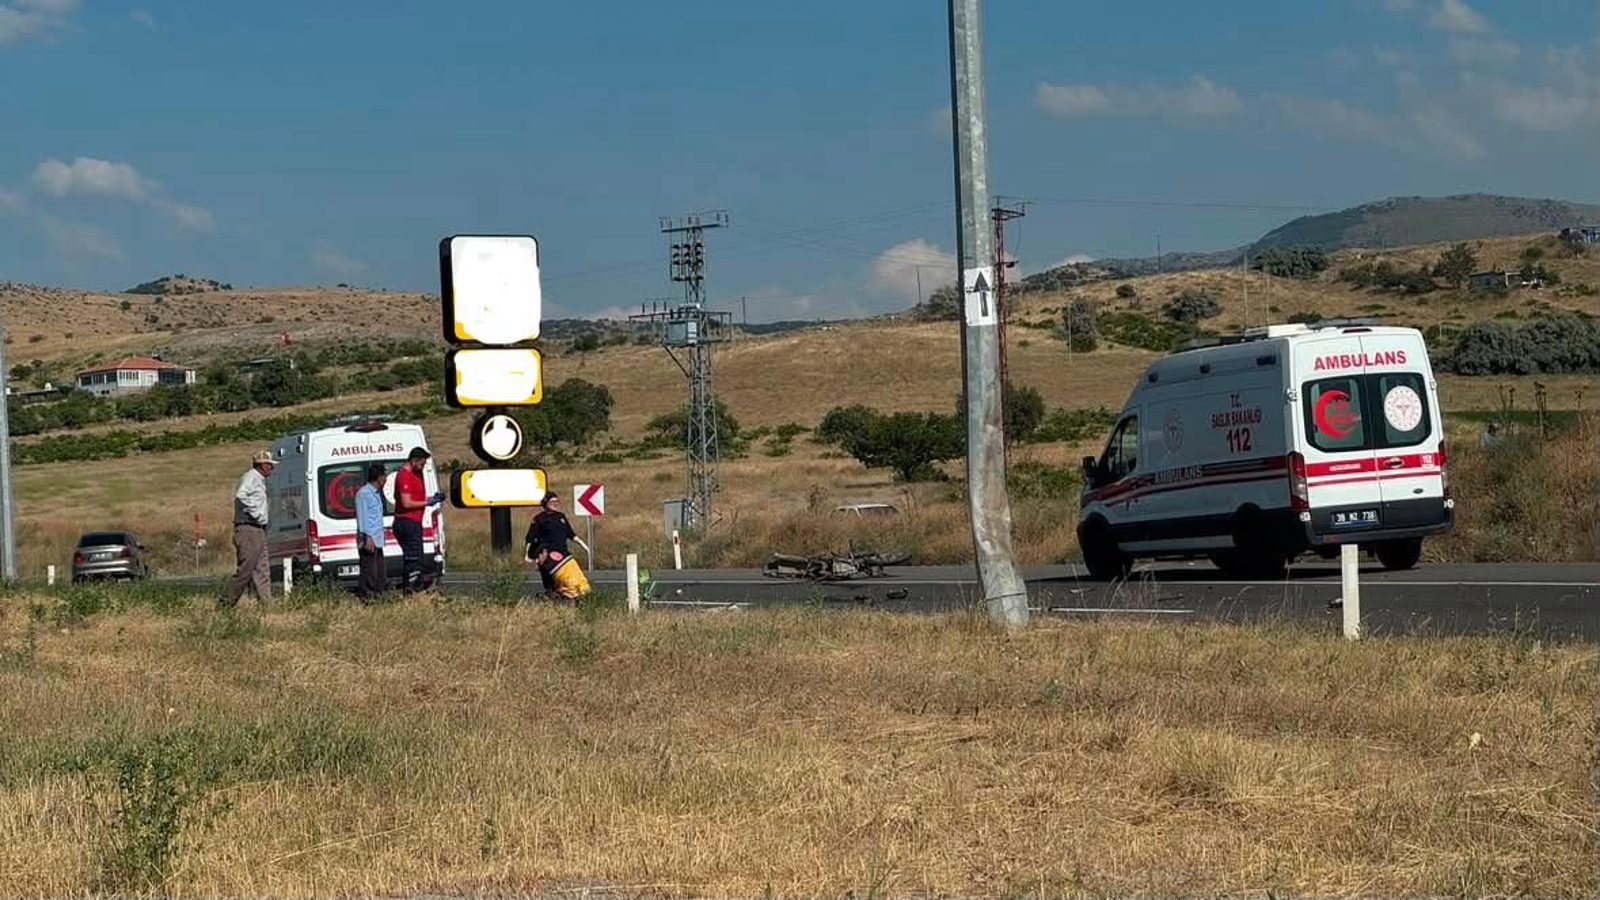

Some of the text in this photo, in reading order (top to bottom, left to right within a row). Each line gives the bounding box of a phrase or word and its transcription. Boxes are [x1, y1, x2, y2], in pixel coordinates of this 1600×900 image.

[1313, 350, 1407, 371] AMBULANS
[331, 443, 404, 457] AMBULANS
[1226, 427, 1252, 454] 112
